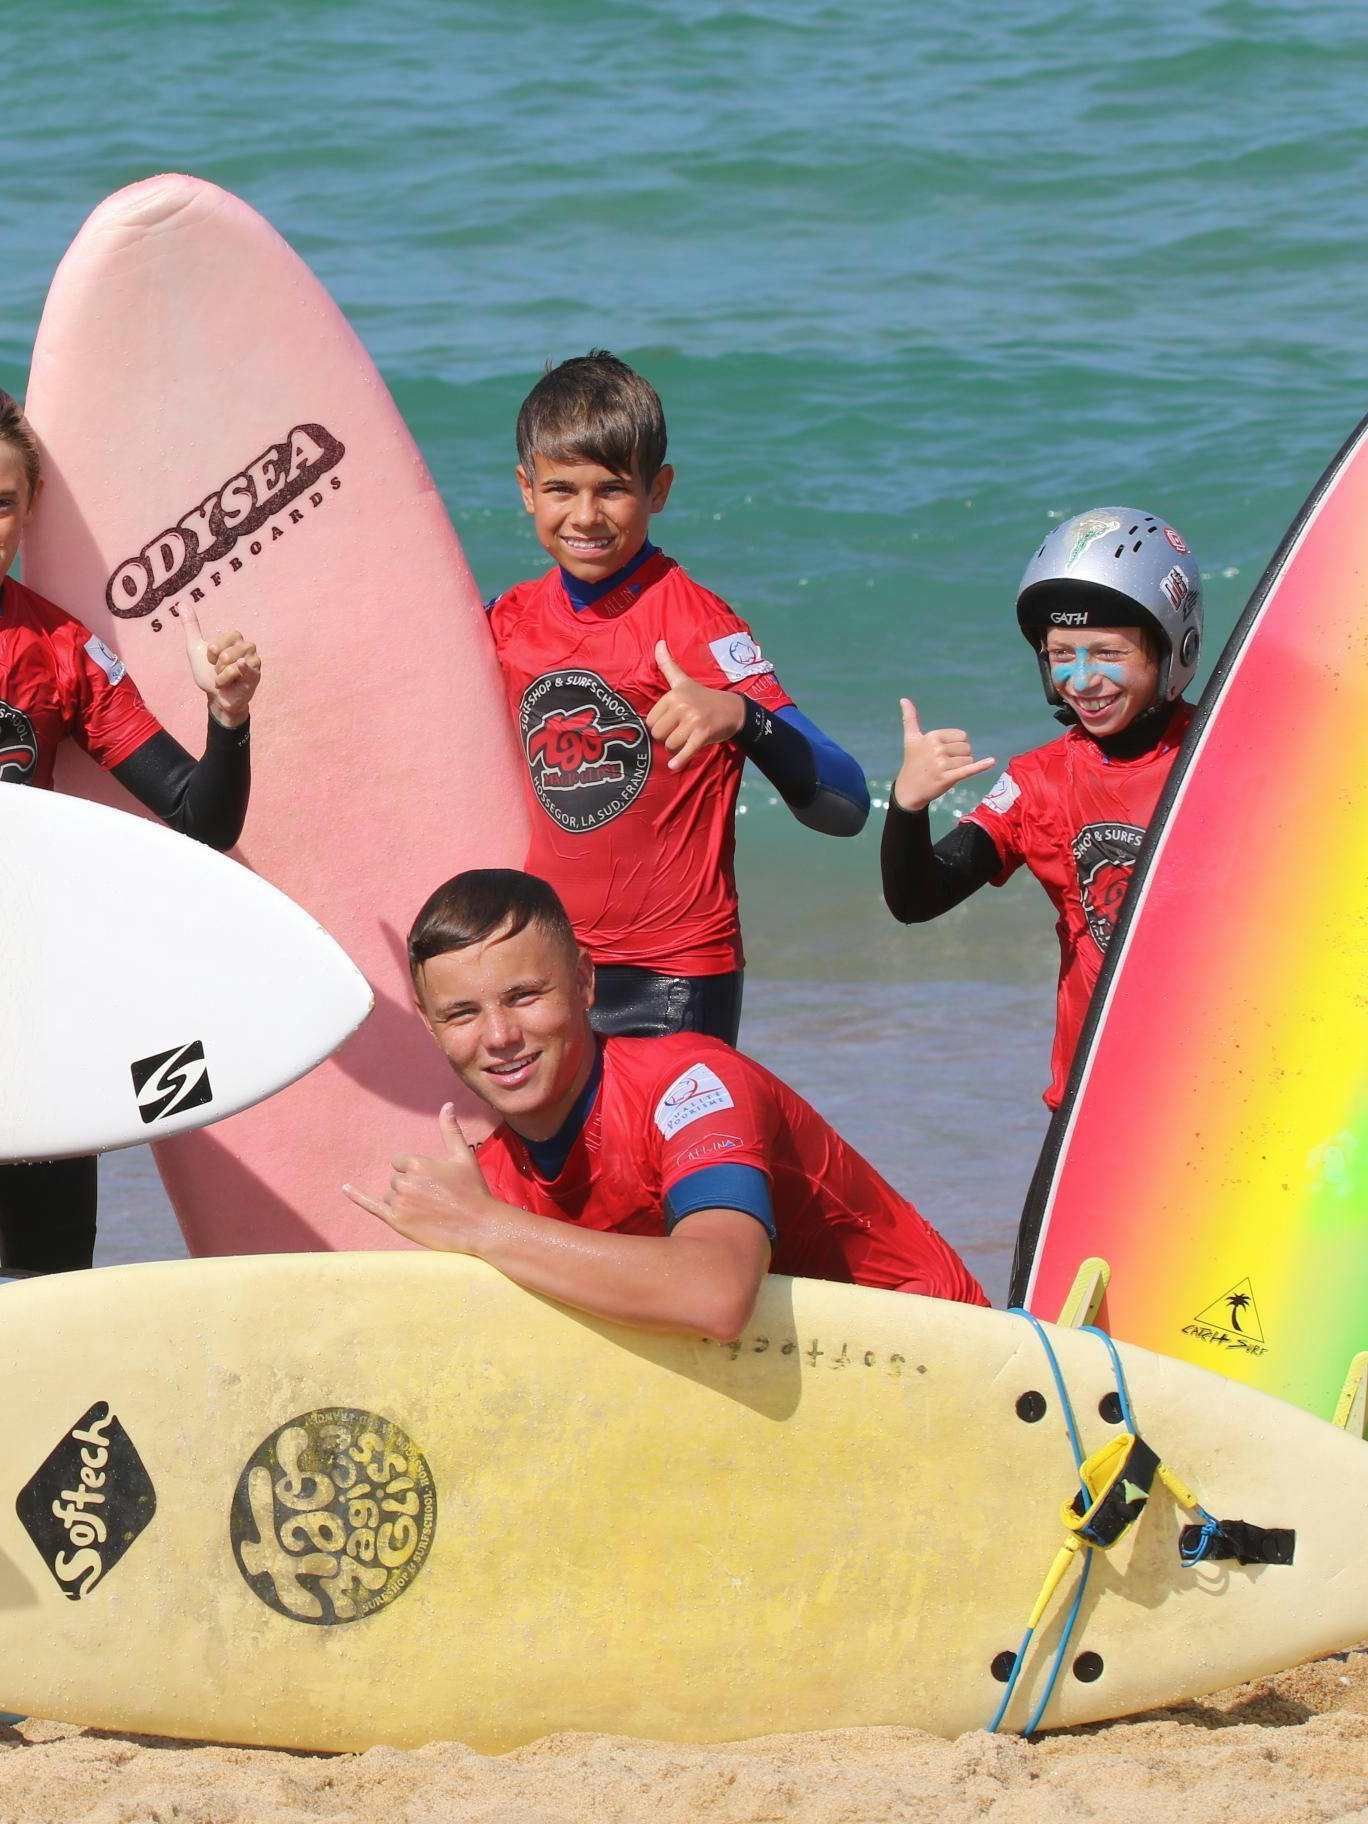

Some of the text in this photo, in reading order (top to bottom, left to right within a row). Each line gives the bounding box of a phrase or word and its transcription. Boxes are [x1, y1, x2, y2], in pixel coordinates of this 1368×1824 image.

[106, 424, 345, 618] ODYSEA
[151, 476, 342, 633] SURFBOARDS
[1050, 611, 1088, 625] GATH
[554, 677, 563, 688] &
[581, 816, 596, 827] LA
[621, 753, 648, 800] FRANCE
[1094, 830, 1103, 842] &
[52, 1416, 111, 1594] Softech
[412, 1496, 435, 1565] SURFSCHOOL
